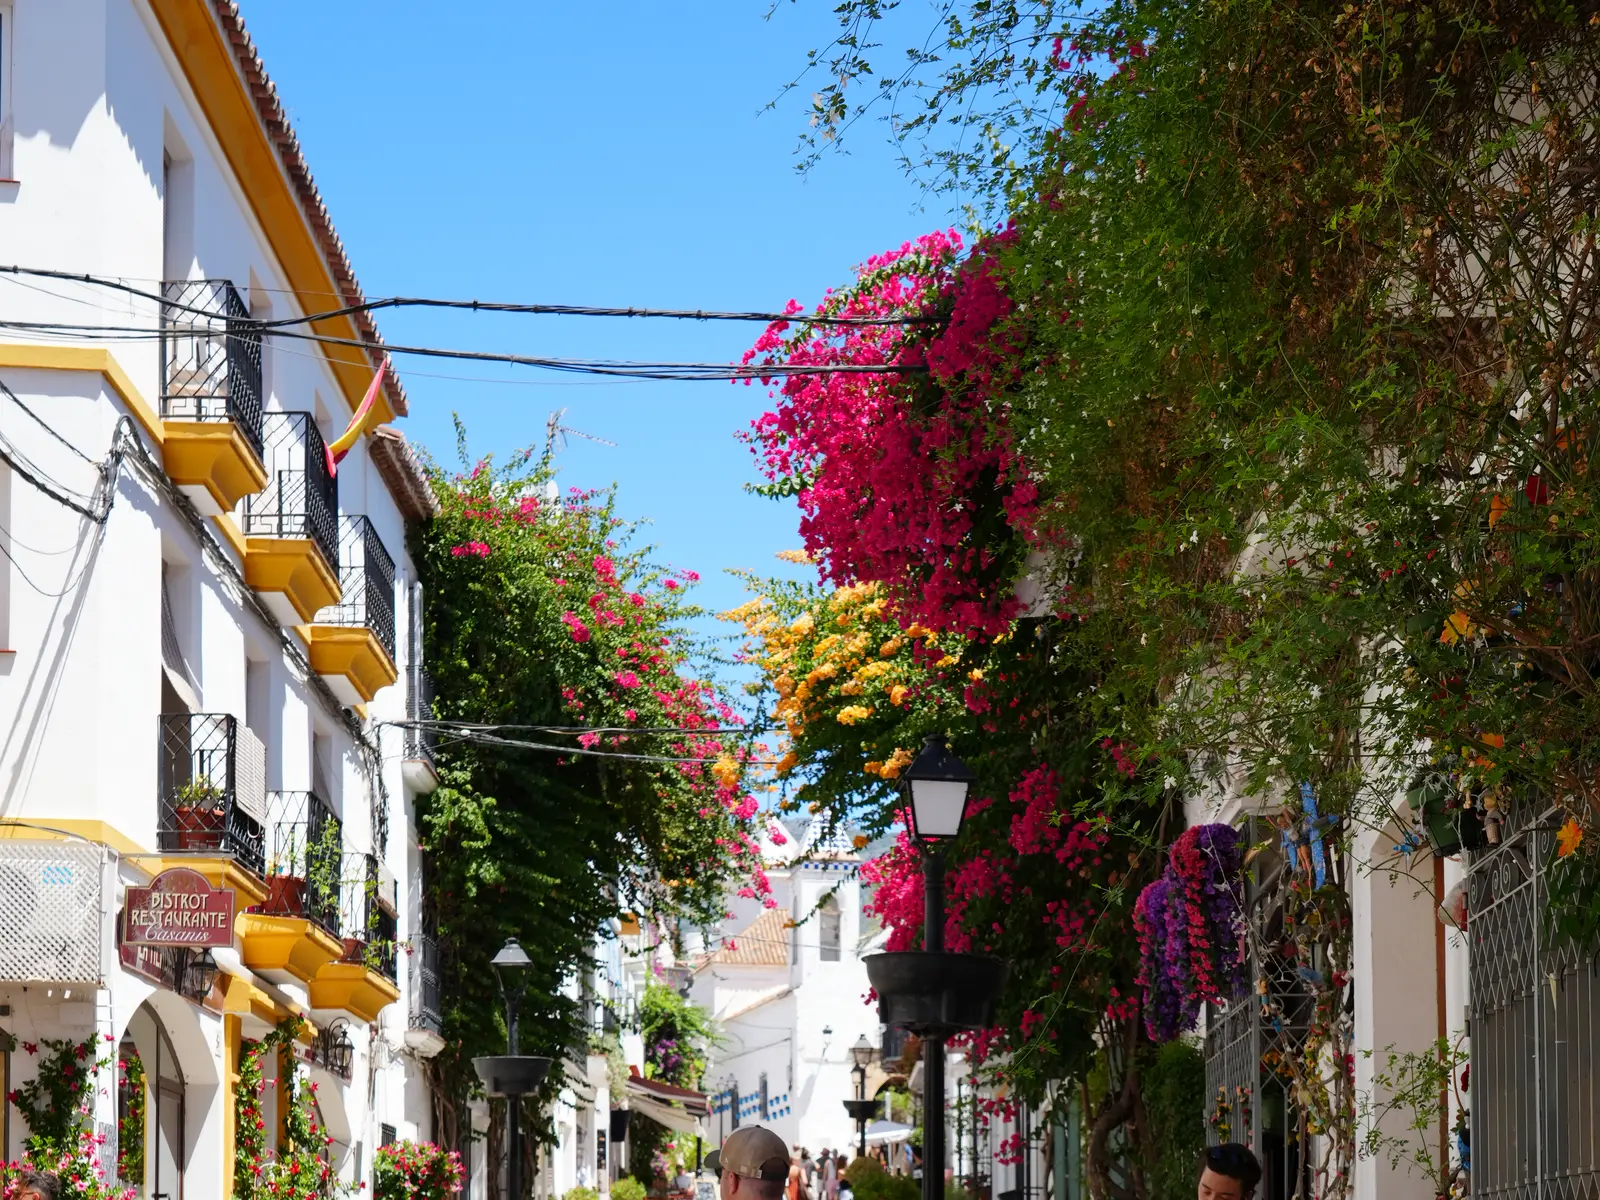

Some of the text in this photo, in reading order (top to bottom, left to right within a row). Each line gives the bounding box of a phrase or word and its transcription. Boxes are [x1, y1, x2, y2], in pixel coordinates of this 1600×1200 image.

[151, 892, 208, 910] BISTROT
[131, 910, 226, 928] RESTAURANTE
[145, 923, 210, 942] Casanis
